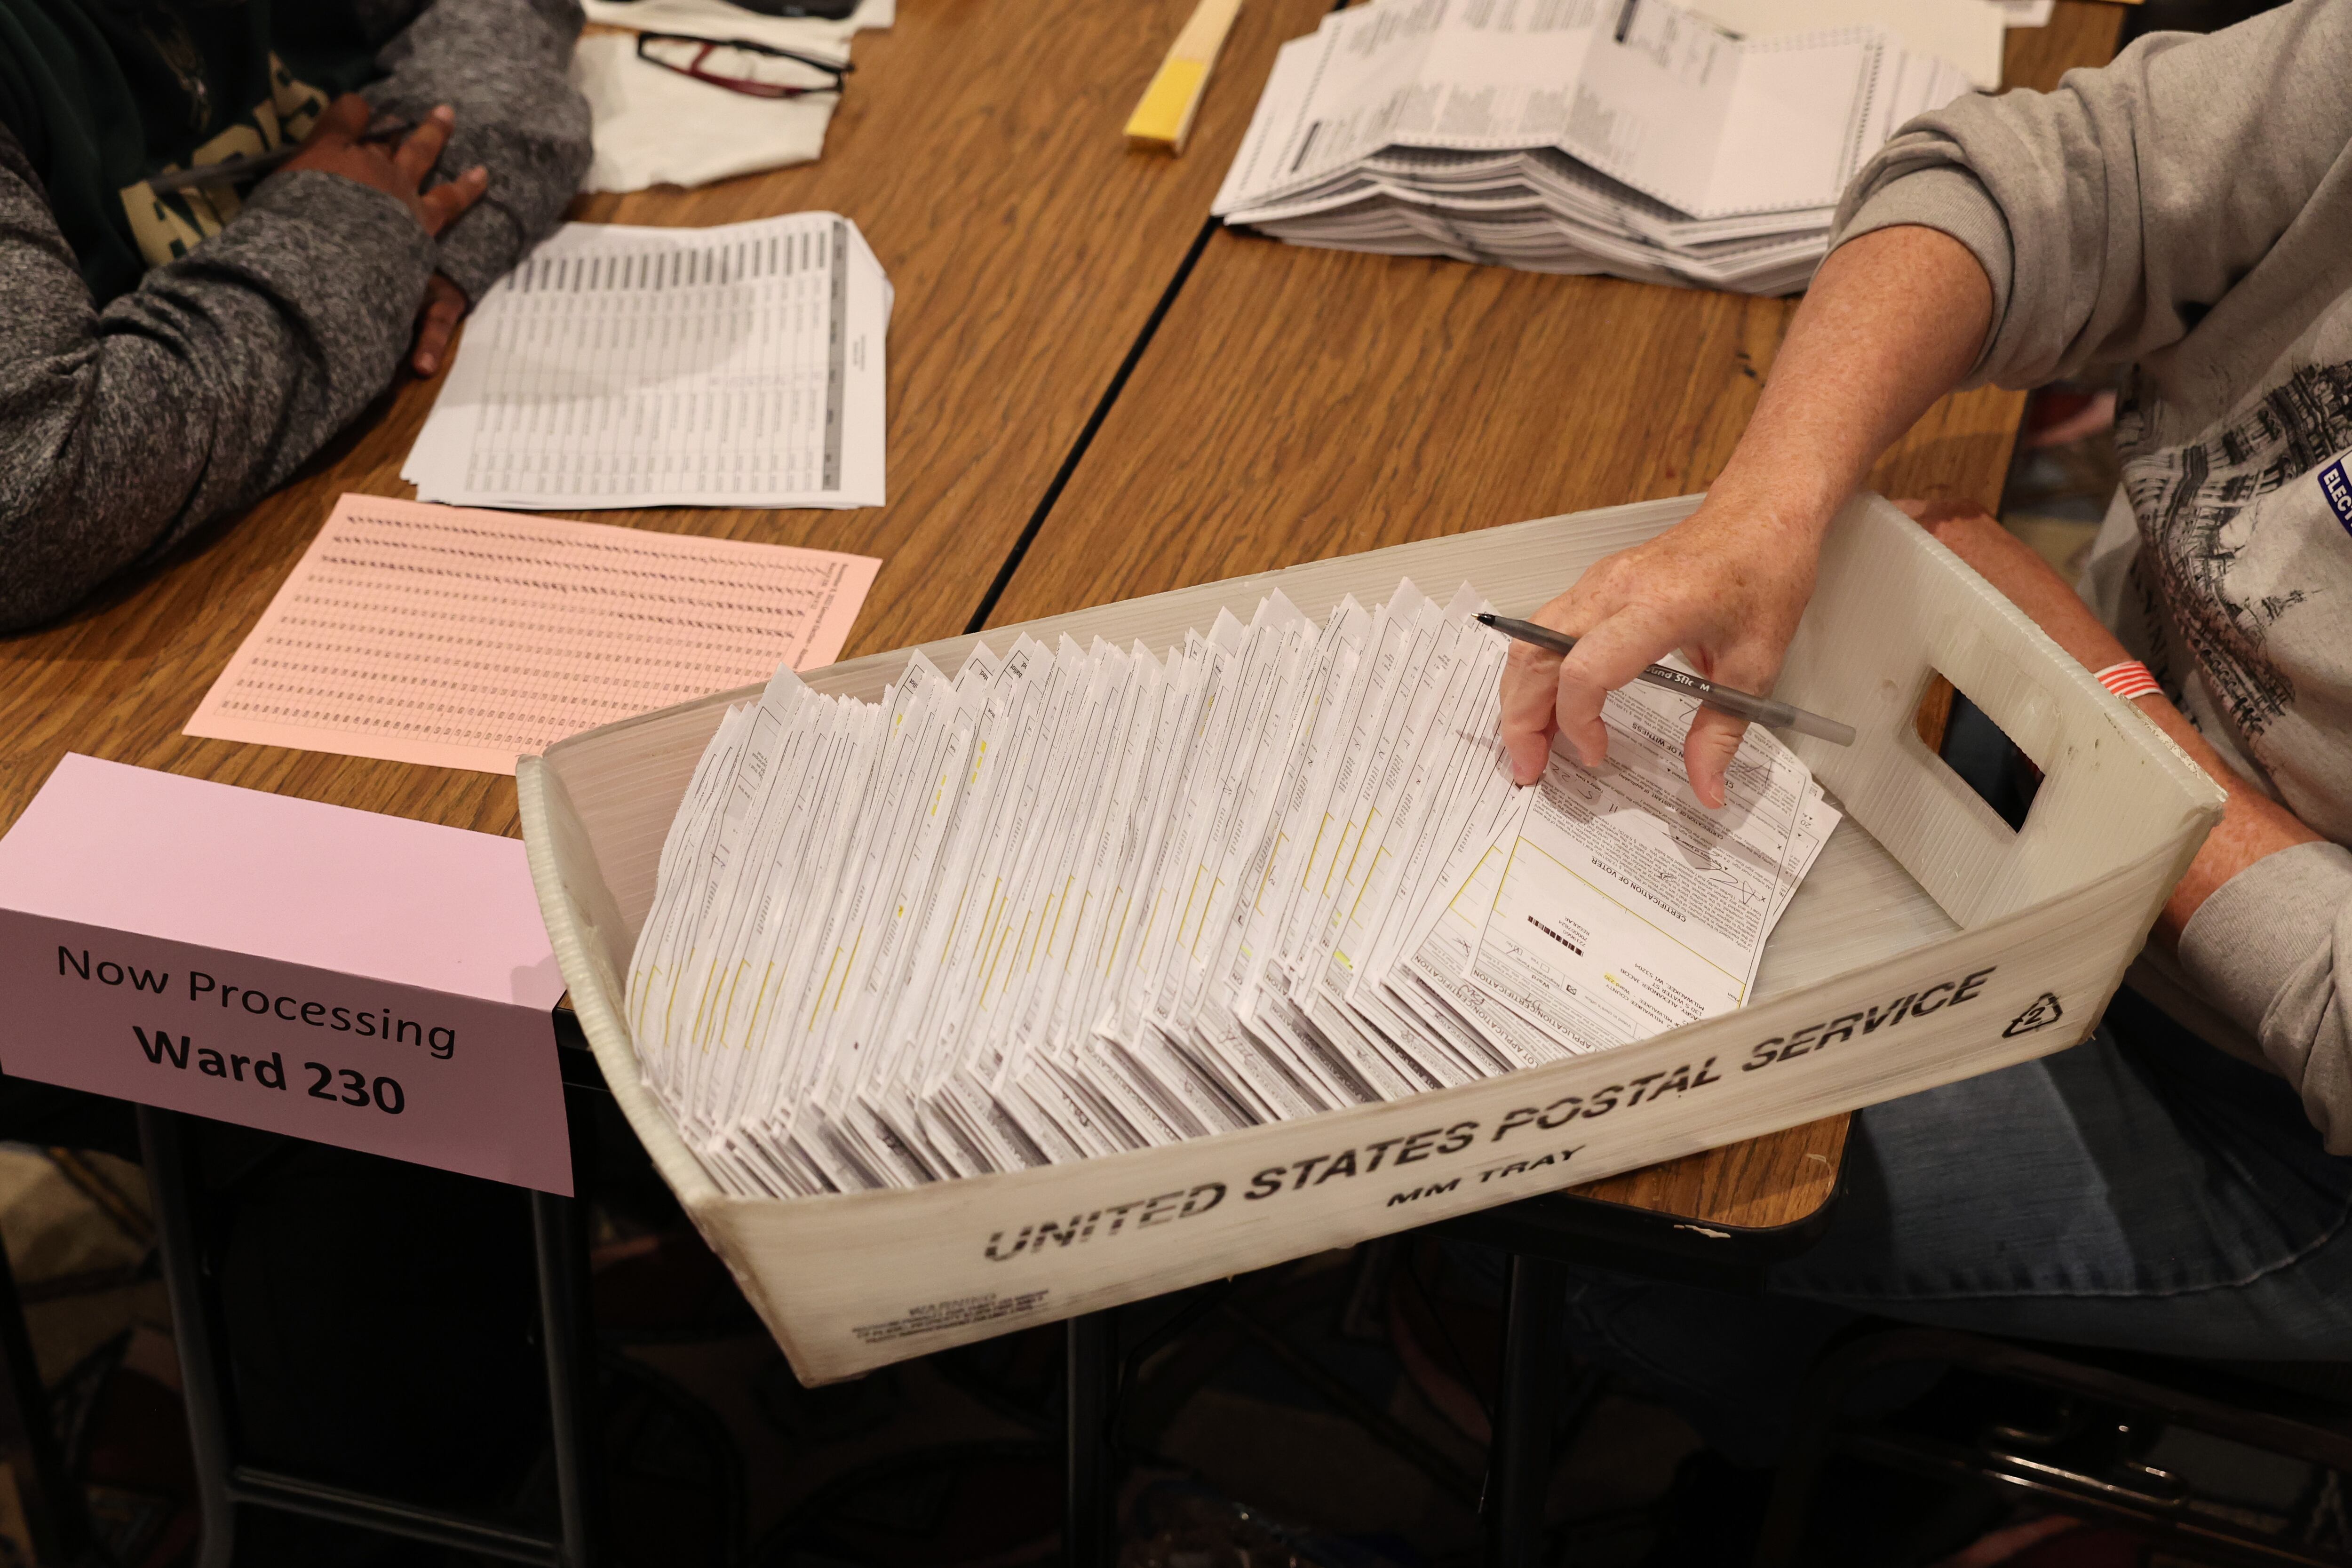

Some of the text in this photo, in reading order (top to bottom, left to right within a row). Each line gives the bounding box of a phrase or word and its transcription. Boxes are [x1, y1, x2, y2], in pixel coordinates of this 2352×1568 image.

[1010, 664, 1023, 679] ballot
[1700, 683, 1710, 692] M
[1632, 723, 1677, 753] OF WITNESS
[1800, 820, 1811, 828] 20
[1591, 858, 1616, 877] VOTER
[1630, 883, 1685, 922] CERTIFICATION
[1565, 917, 1589, 936] REGULAR
[1563, 930, 1585, 946] 7219660
[1531, 966, 1560, 987] Registration
[1532, 975, 1549, 989] Ward
[1604, 975, 1614, 984] 230
[1621, 968, 1639, 983] JACOB
[1616, 983, 1629, 995] Ward
[1635, 963, 1704, 1011] MILWAUKEE, WI 53204
[1642, 984, 1677, 1007] ALEXANDER
[1662, 988, 1683, 1004] WATER
[56, 944, 459, 1061] Now Processing
[1606, 984, 1663, 1024] MILWAUKEE COUNTY
[1641, 1000, 1672, 1022] MILWAUKEE
[1691, 1007, 1702, 1016] 130
[1618, 1018, 1631, 1028] Voted
[135, 1024, 404, 1114] Ward 230
[983, 964, 1999, 1263] UNITED STATES POSTAL SERVICE
[1386, 1144, 1587, 1208] MM TRAY
